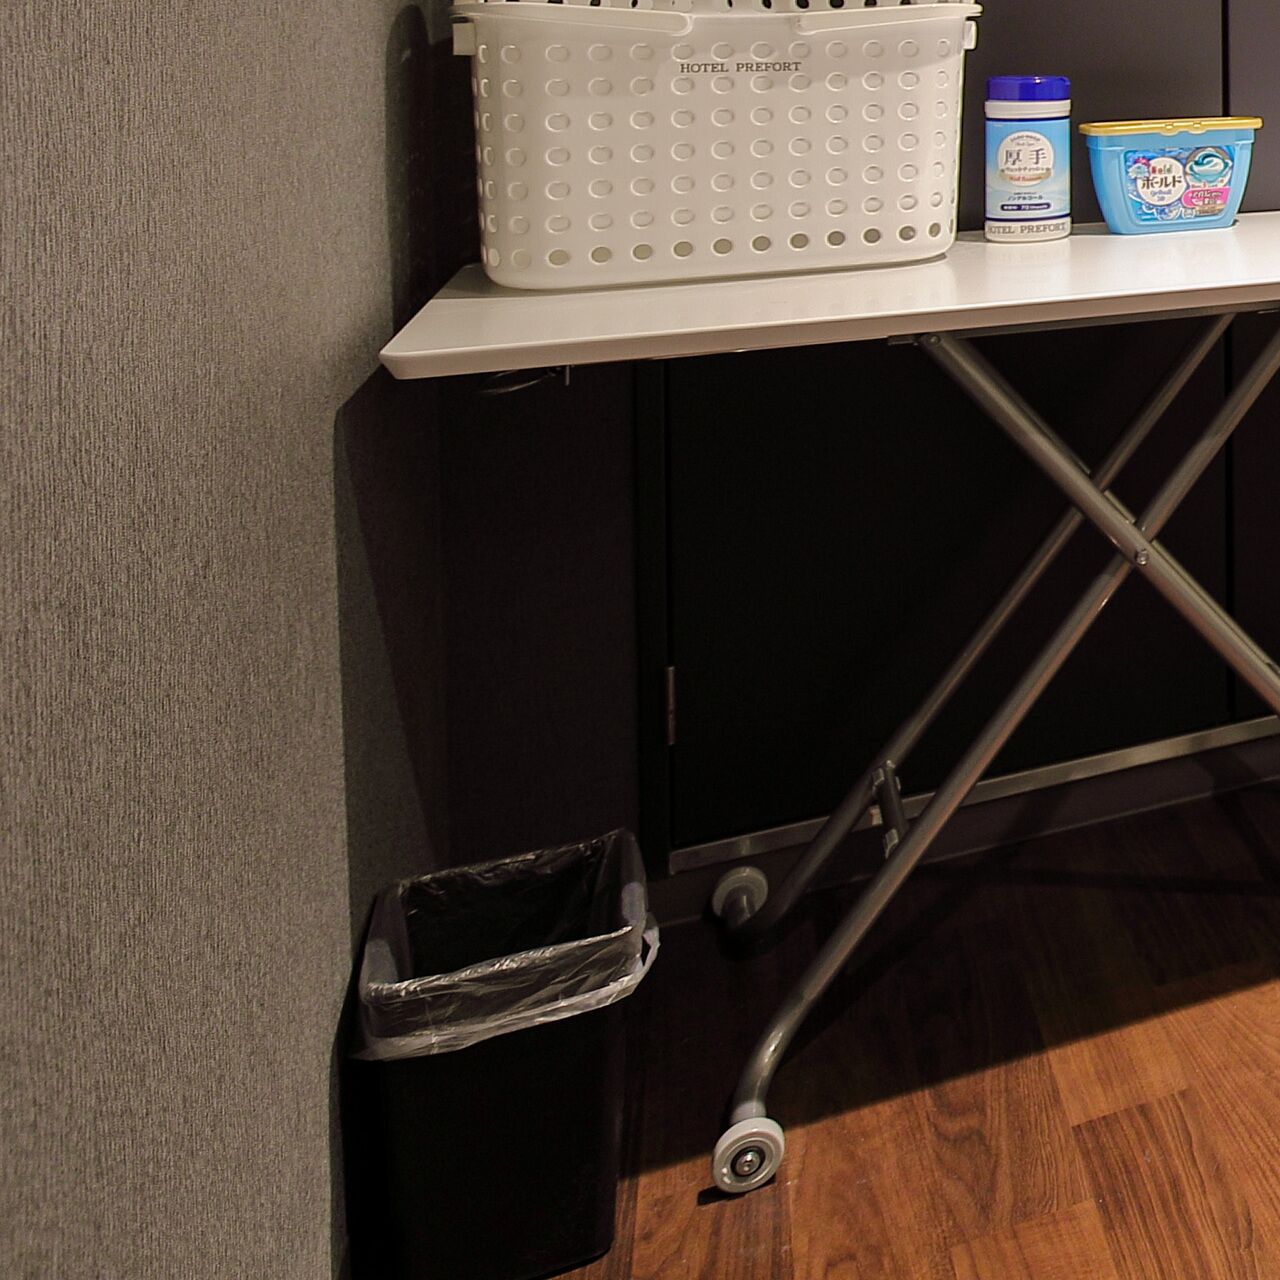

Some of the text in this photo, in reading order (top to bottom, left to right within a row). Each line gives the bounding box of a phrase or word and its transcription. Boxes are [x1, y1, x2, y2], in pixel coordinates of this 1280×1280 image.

[680, 62, 802, 73] HOTEL PREFORT
[1004, 148, 1047, 165] 厚手
[1141, 176, 1182, 189] ボールド
[1020, 222, 1066, 234] PREFORT
